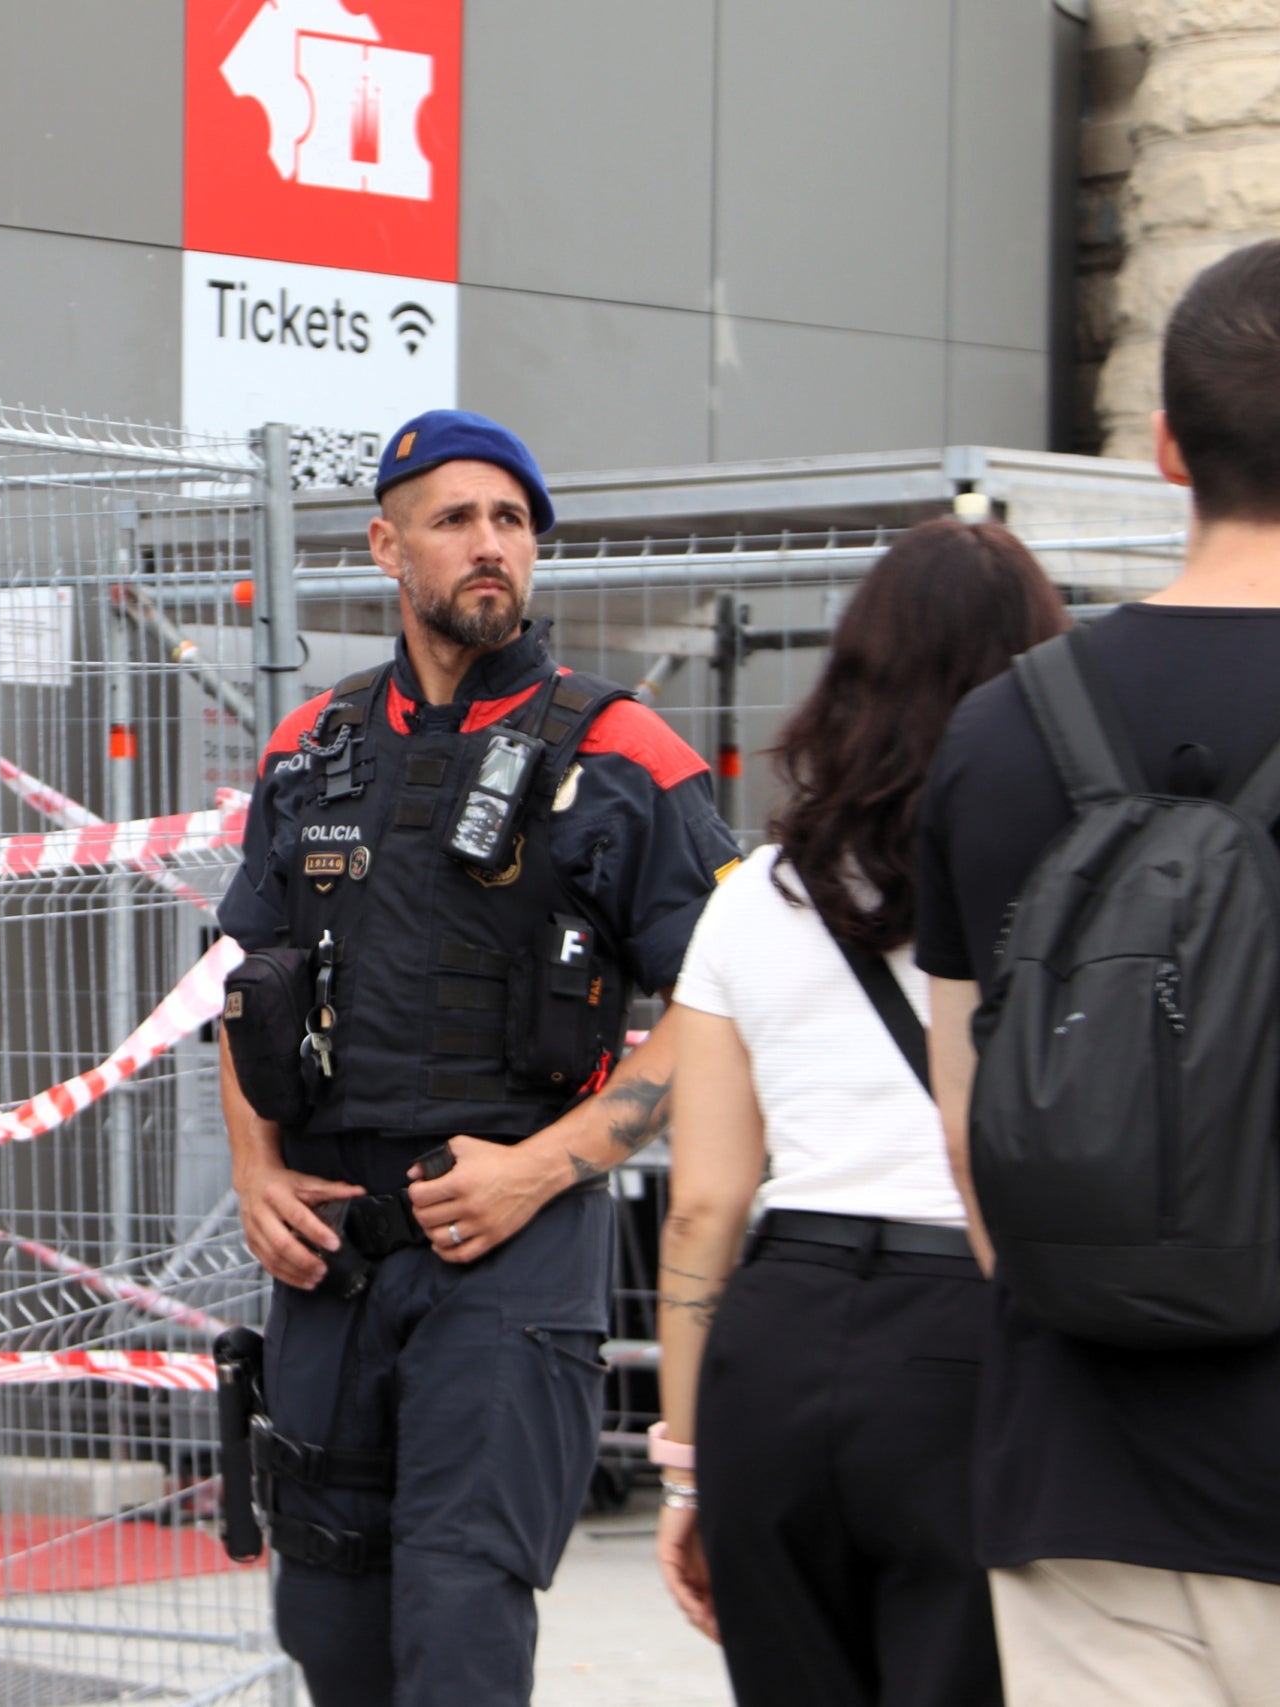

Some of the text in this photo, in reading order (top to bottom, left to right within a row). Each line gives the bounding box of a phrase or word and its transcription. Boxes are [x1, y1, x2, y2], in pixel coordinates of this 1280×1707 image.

[207, 279, 369, 353] Tickets
[301, 825, 361, 842] POLICIA
[560, 929, 584, 963] F
